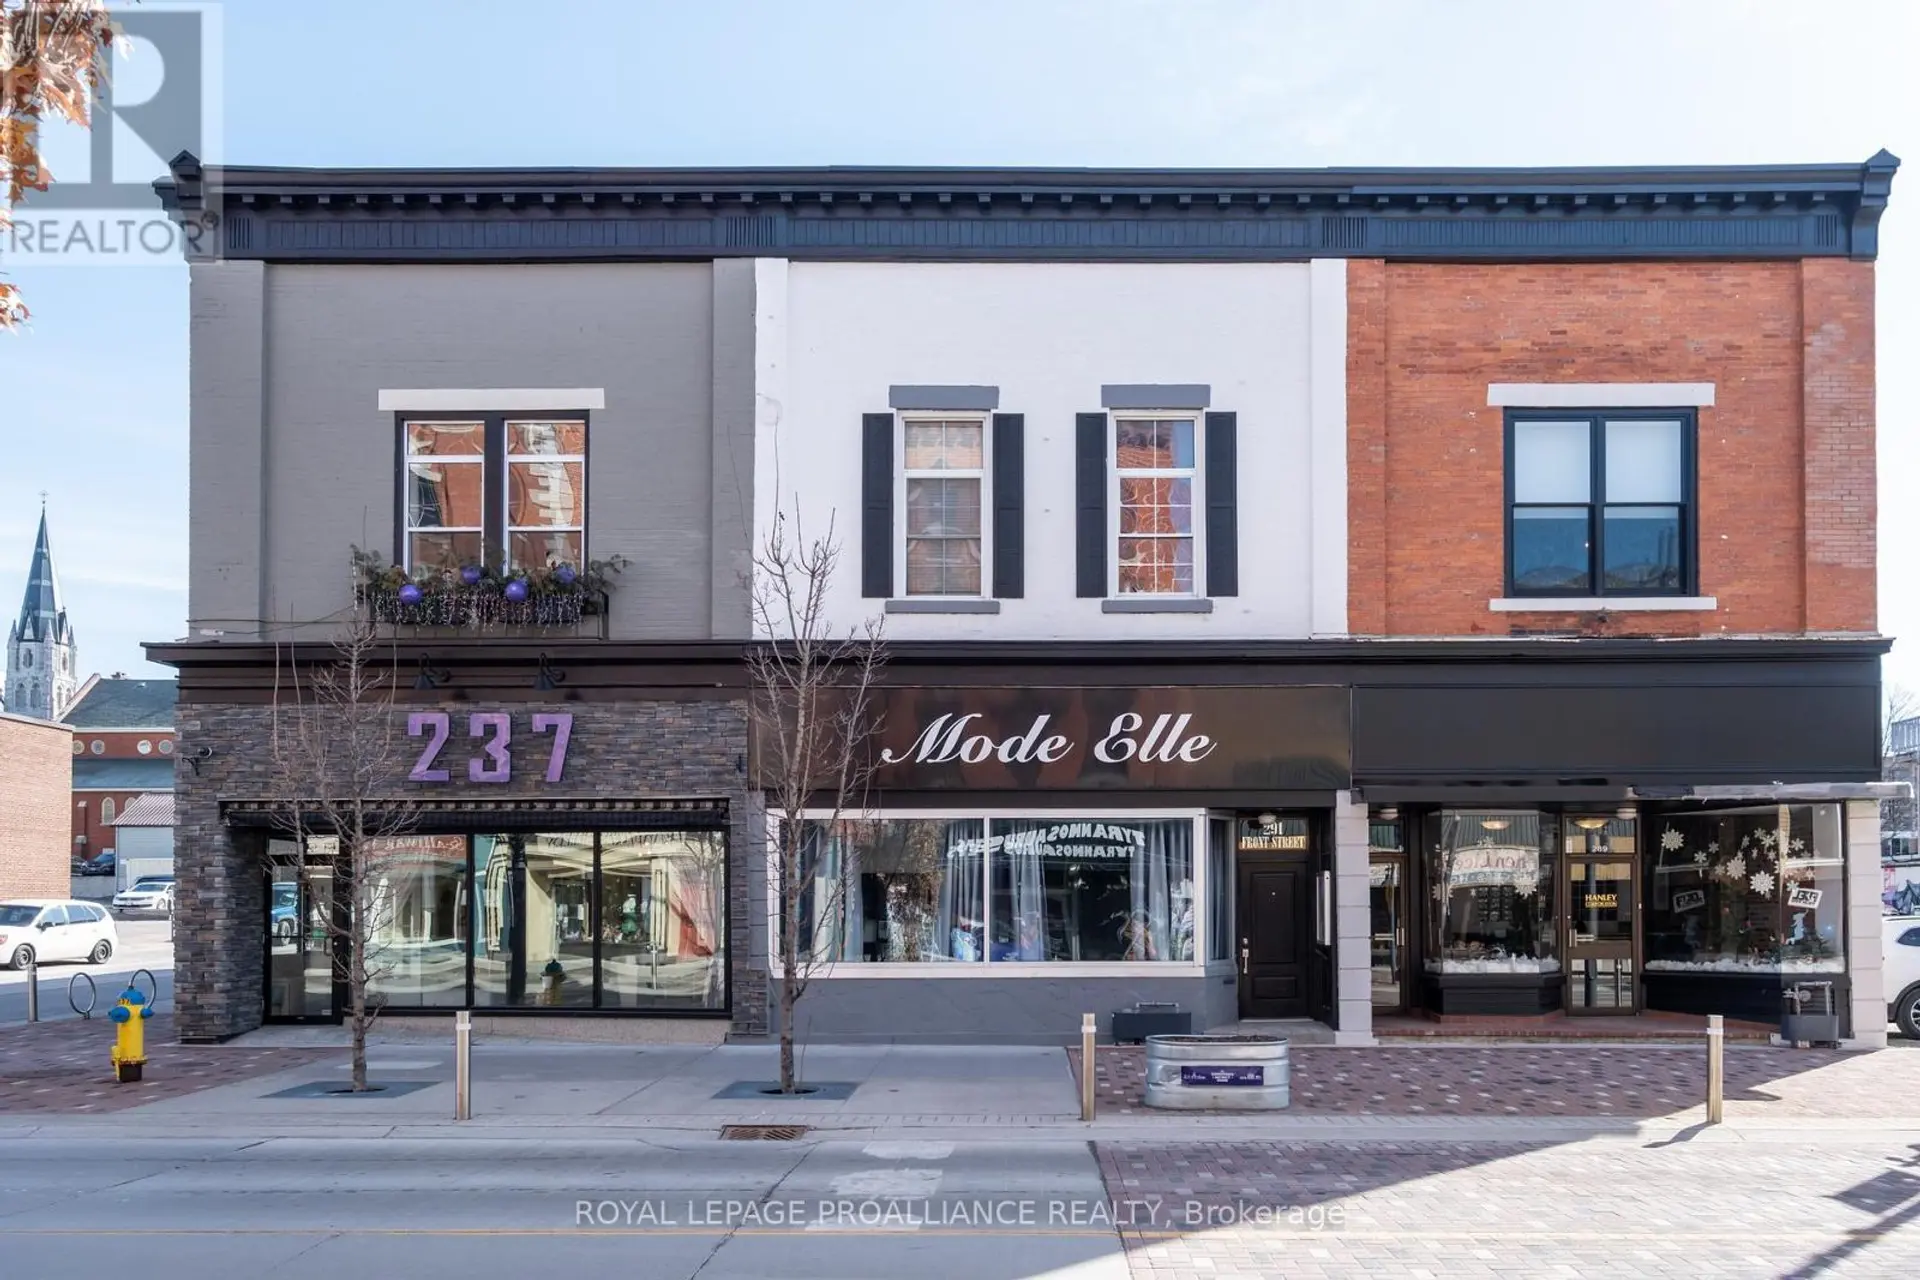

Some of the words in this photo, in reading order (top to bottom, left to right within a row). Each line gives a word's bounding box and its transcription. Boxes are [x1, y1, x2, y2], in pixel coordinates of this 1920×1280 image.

[881, 712, 1074, 765] Mode
[1094, 712, 1217, 764] Elle
[407, 711, 574, 783] 237
[1263, 823, 1283, 835] 291
[1241, 836, 1269, 849] FRONT
[1271, 836, 1306, 849] STREET
[1585, 893, 1617, 902] HANLEY
